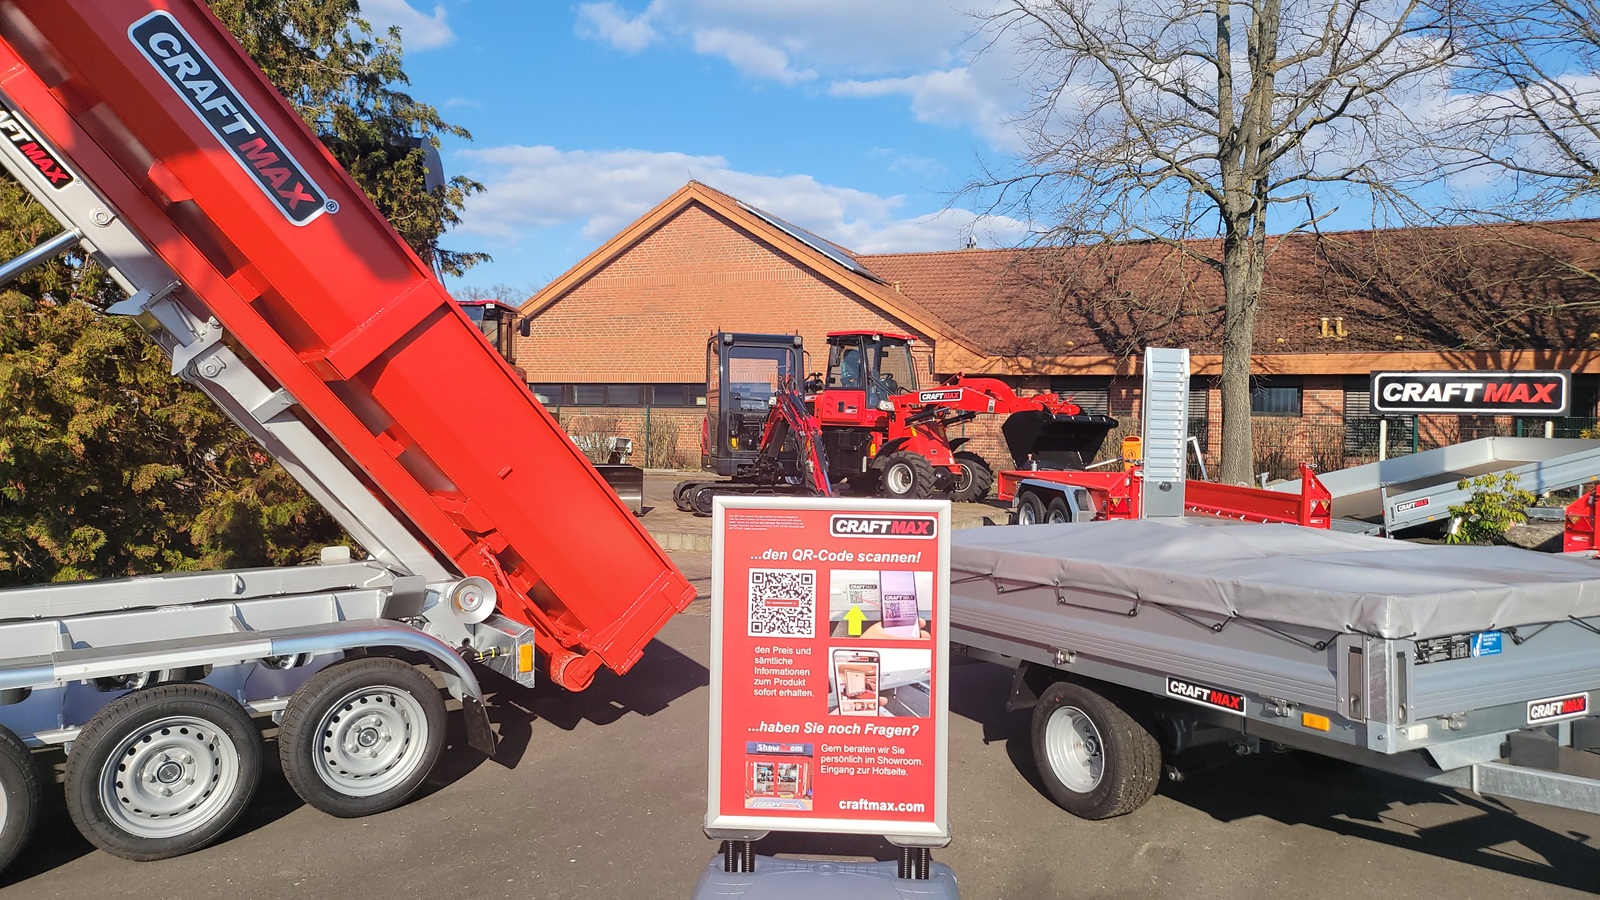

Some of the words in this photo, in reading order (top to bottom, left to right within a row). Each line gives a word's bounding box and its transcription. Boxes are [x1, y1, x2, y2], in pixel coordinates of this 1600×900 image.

[149, 32, 315, 209] CRAFTMAX
[1383, 383, 1557, 403] CRAFTMAX
[836, 519, 928, 534] CRAFTMAX
[750, 548, 788, 561] ...den
[791, 549, 854, 563] QR-Code
[857, 551, 921, 563] scannen!
[755, 645, 770, 654] den
[772, 646, 793, 655] Preis
[796, 646, 812, 655] und
[754, 656, 793, 665] sämtliche
[754, 667, 810, 676] Informationen
[773, 678, 806, 687] Produkt
[754, 688, 777, 697] sofort
[779, 689, 815, 698] erhalten.
[1170, 680, 1240, 709] CRAFTMAX
[1531, 698, 1585, 719] CRAFTMAX
[748, 721, 800, 733] ...haben
[803, 722, 825, 734] Sie
[828, 723, 861, 735] noch
[864, 724, 919, 738] Fragen?
[821, 744, 841, 753] Gern
[844, 745, 876, 754] beraten
[877, 746, 890, 754] wir
[891, 746, 905, 755] Sie
[820, 754, 863, 765] persönlich
[864, 756, 875, 764] im
[877, 757, 924, 766] Showroom.
[820, 766, 854, 776] Eingang
[872, 767, 909, 777] Hofseite.
[839, 799, 925, 812] craftmax.com
